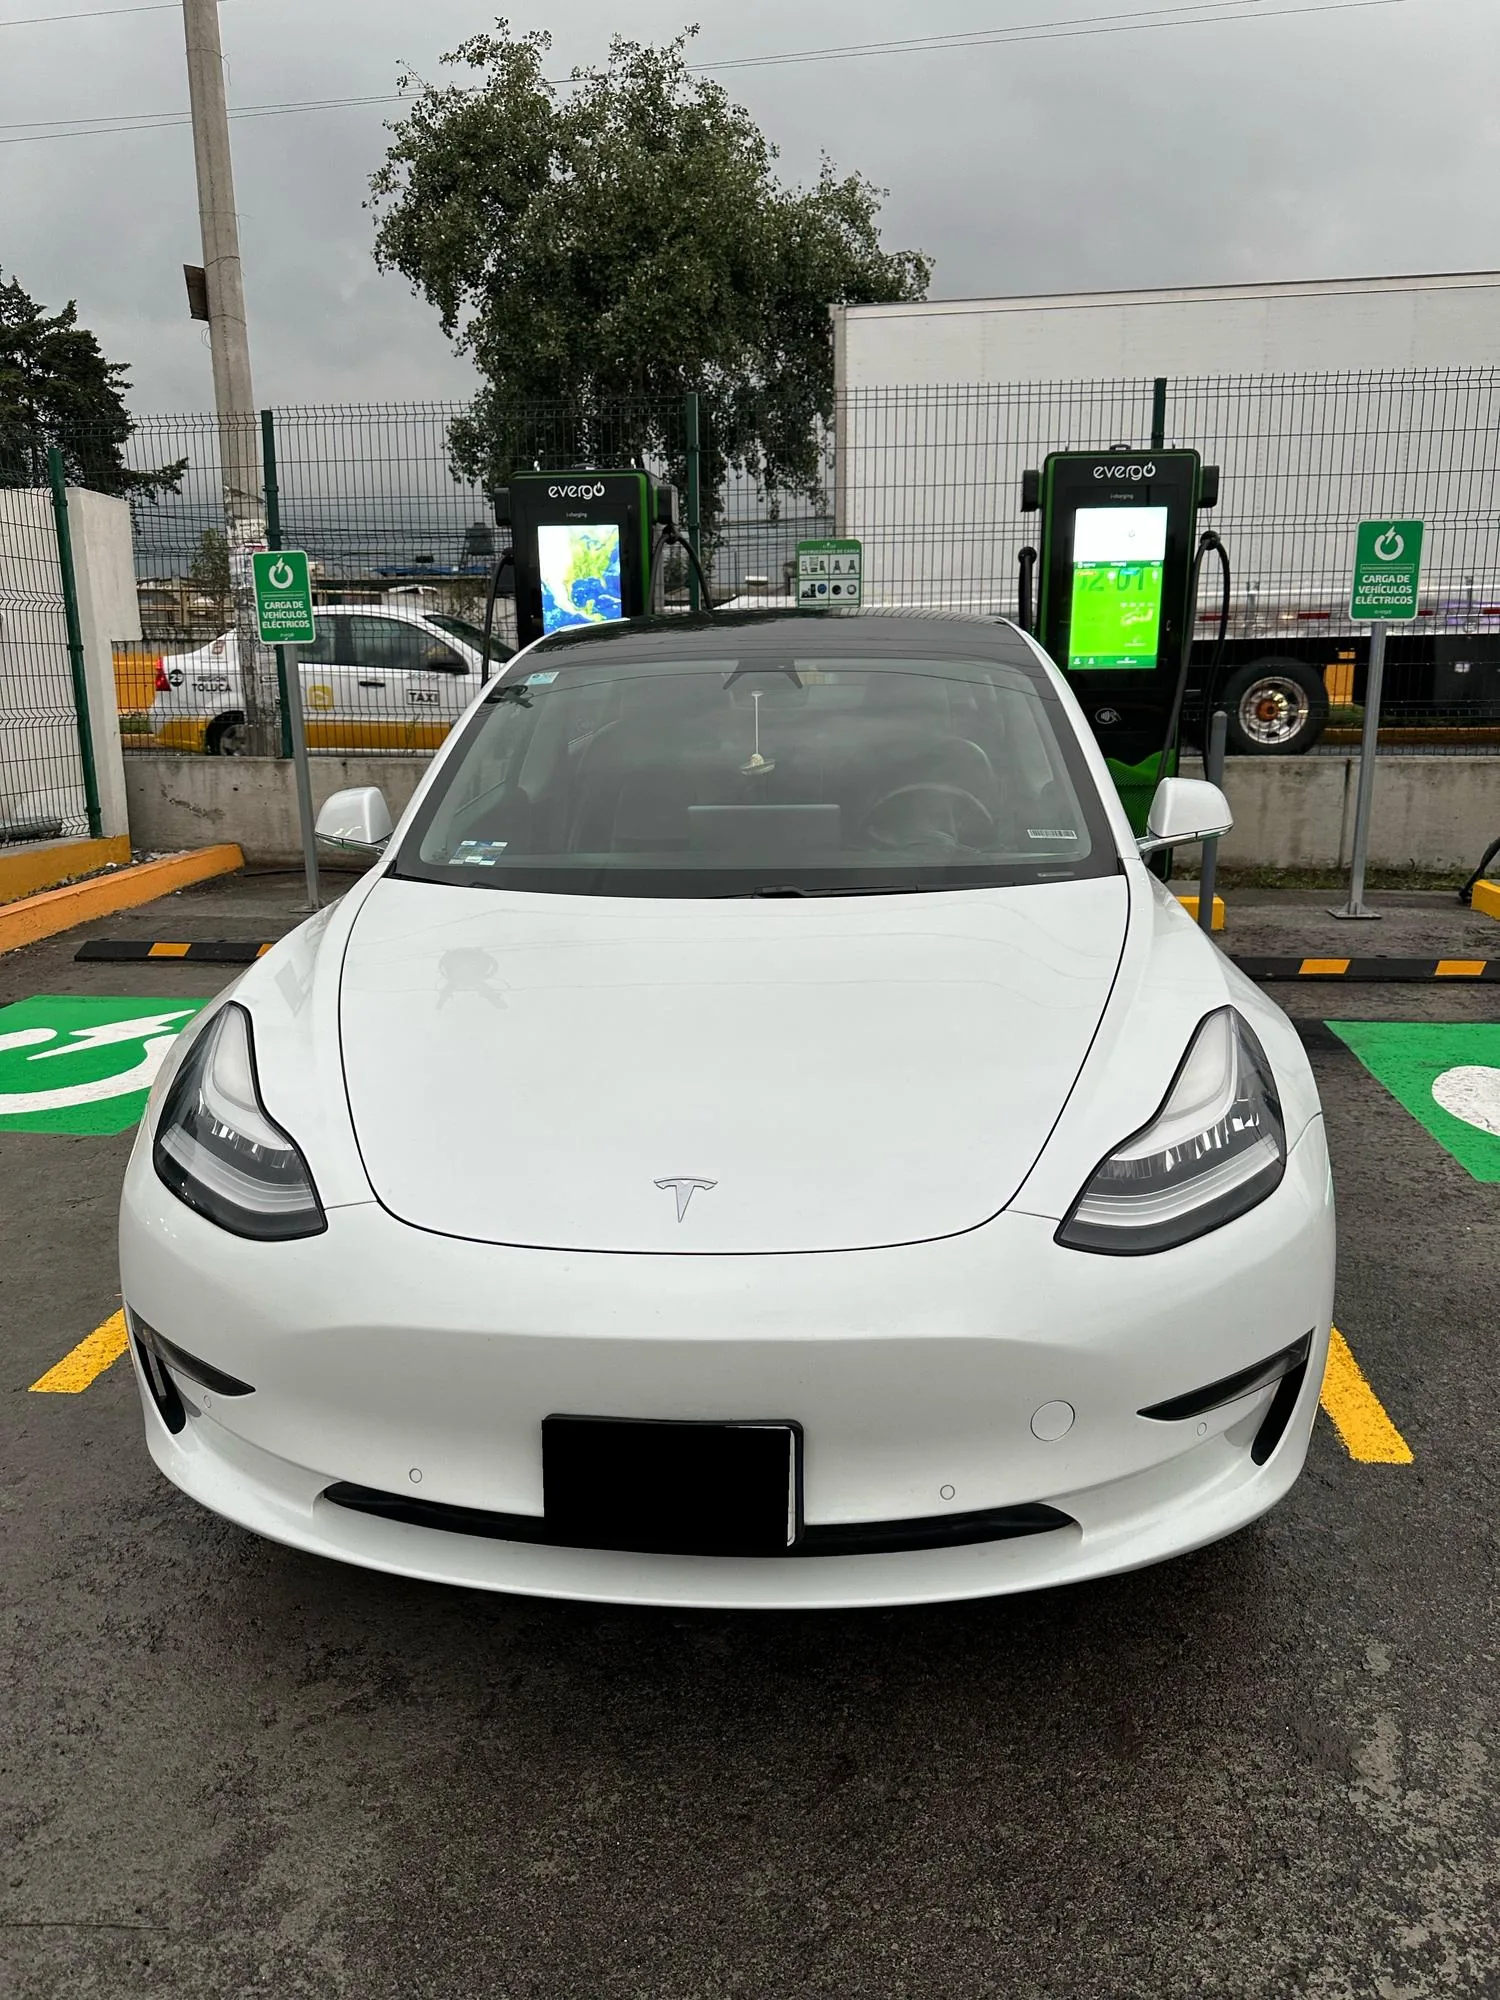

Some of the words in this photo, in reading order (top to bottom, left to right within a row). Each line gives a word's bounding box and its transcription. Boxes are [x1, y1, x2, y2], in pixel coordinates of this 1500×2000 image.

[1362, 575, 1395, 583] CARGA
[1396, 575, 1410, 583] DE
[1358, 584, 1412, 594] VEHÍCULOS
[1355, 594, 1413, 605] ELÉCTRICOS
[264, 601, 291, 610] CARGA
[292, 601, 304, 609] DE
[262, 609, 308, 619] VEHÍCULOS
[261, 619, 310, 629] ELÉCTRICOS
[169, 674, 184, 683] 29
[192, 683, 232, 692] TOLUCA
[409, 692, 438, 703] TAXI
